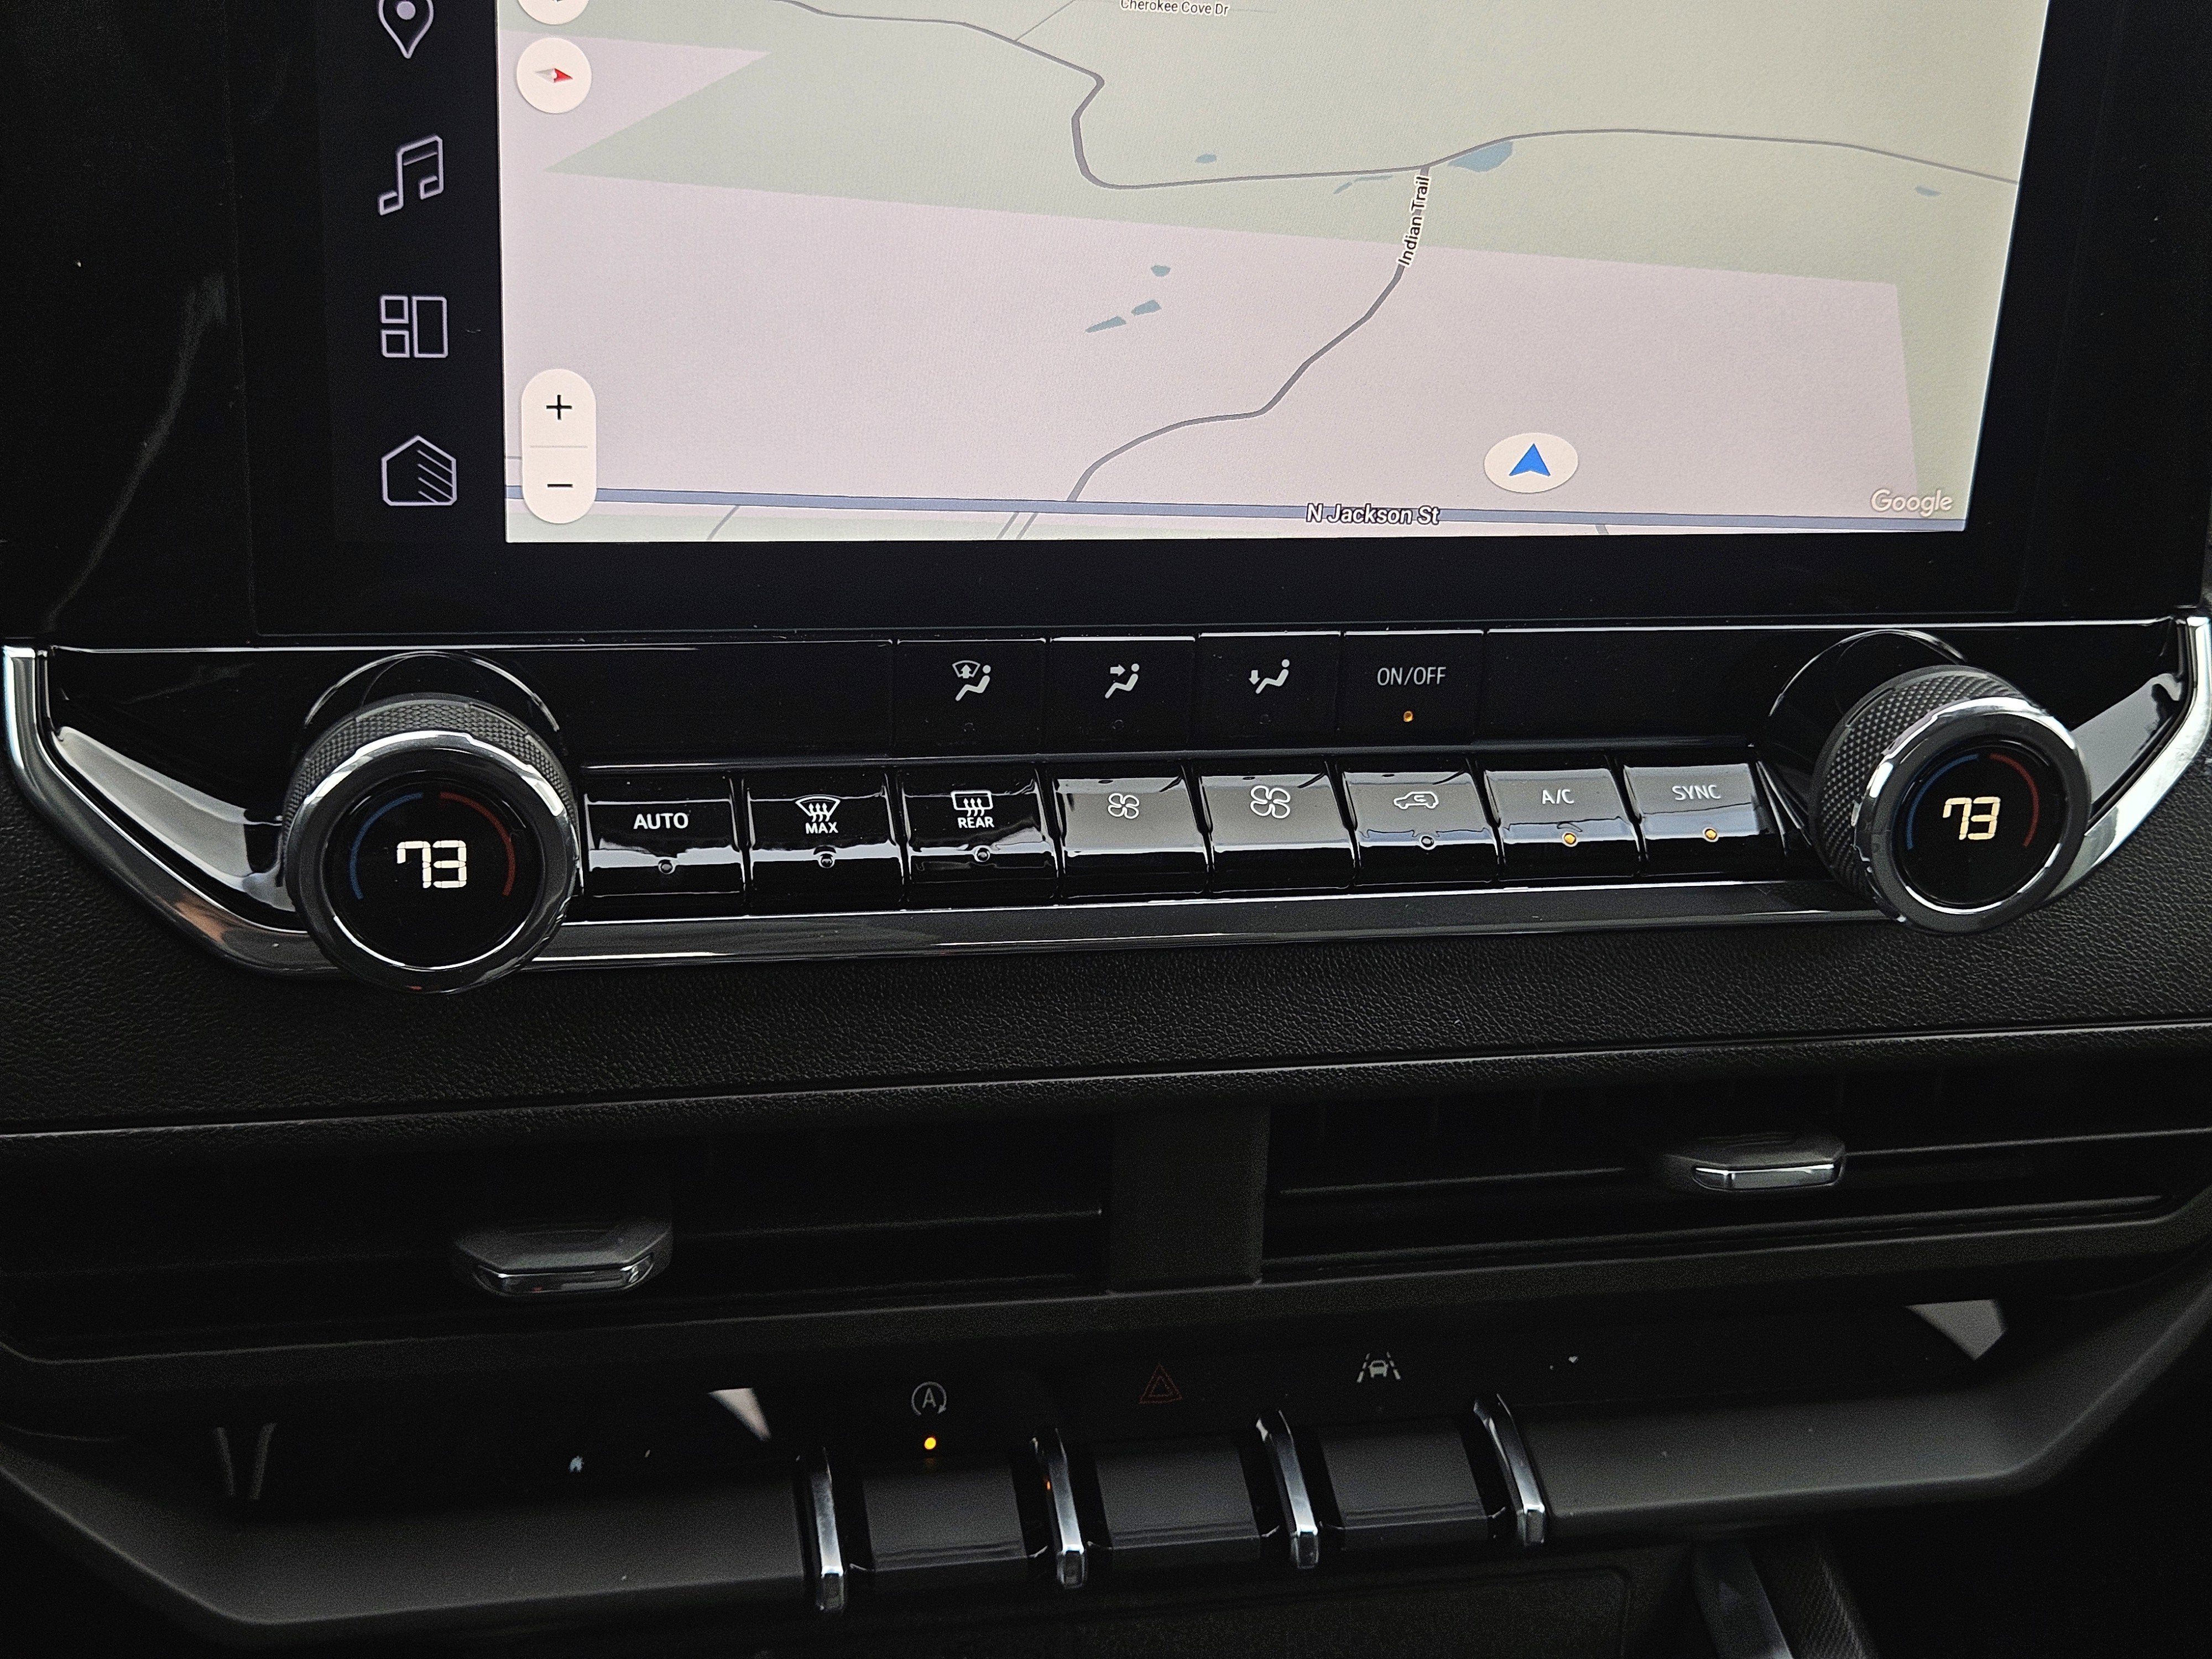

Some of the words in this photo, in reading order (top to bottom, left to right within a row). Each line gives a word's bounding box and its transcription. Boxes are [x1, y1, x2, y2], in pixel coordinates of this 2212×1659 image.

[1120, 0, 1178, 12] Cherokee
[1181, 1, 1212, 14] Cove
[1215, 3, 1229, 15] Dr
[1397, 216, 1422, 265] Indian
[1411, 176, 1430, 211] Trail
[1871, 488, 1953, 518] Google
[1306, 503, 1323, 523] N
[1327, 503, 1413, 524] Jackson
[1417, 505, 1440, 525] St
[1377, 666, 1447, 686] ON/OFF
[1541, 789, 1575, 805] A/C
[1672, 785, 1721, 801] SYNC
[633, 812, 689, 830] AUTO
[805, 821, 839, 834] MAX
[957, 816, 995, 829] REAR
[1942, 796, 2001, 841] 73
[397, 839, 467, 889] 73
